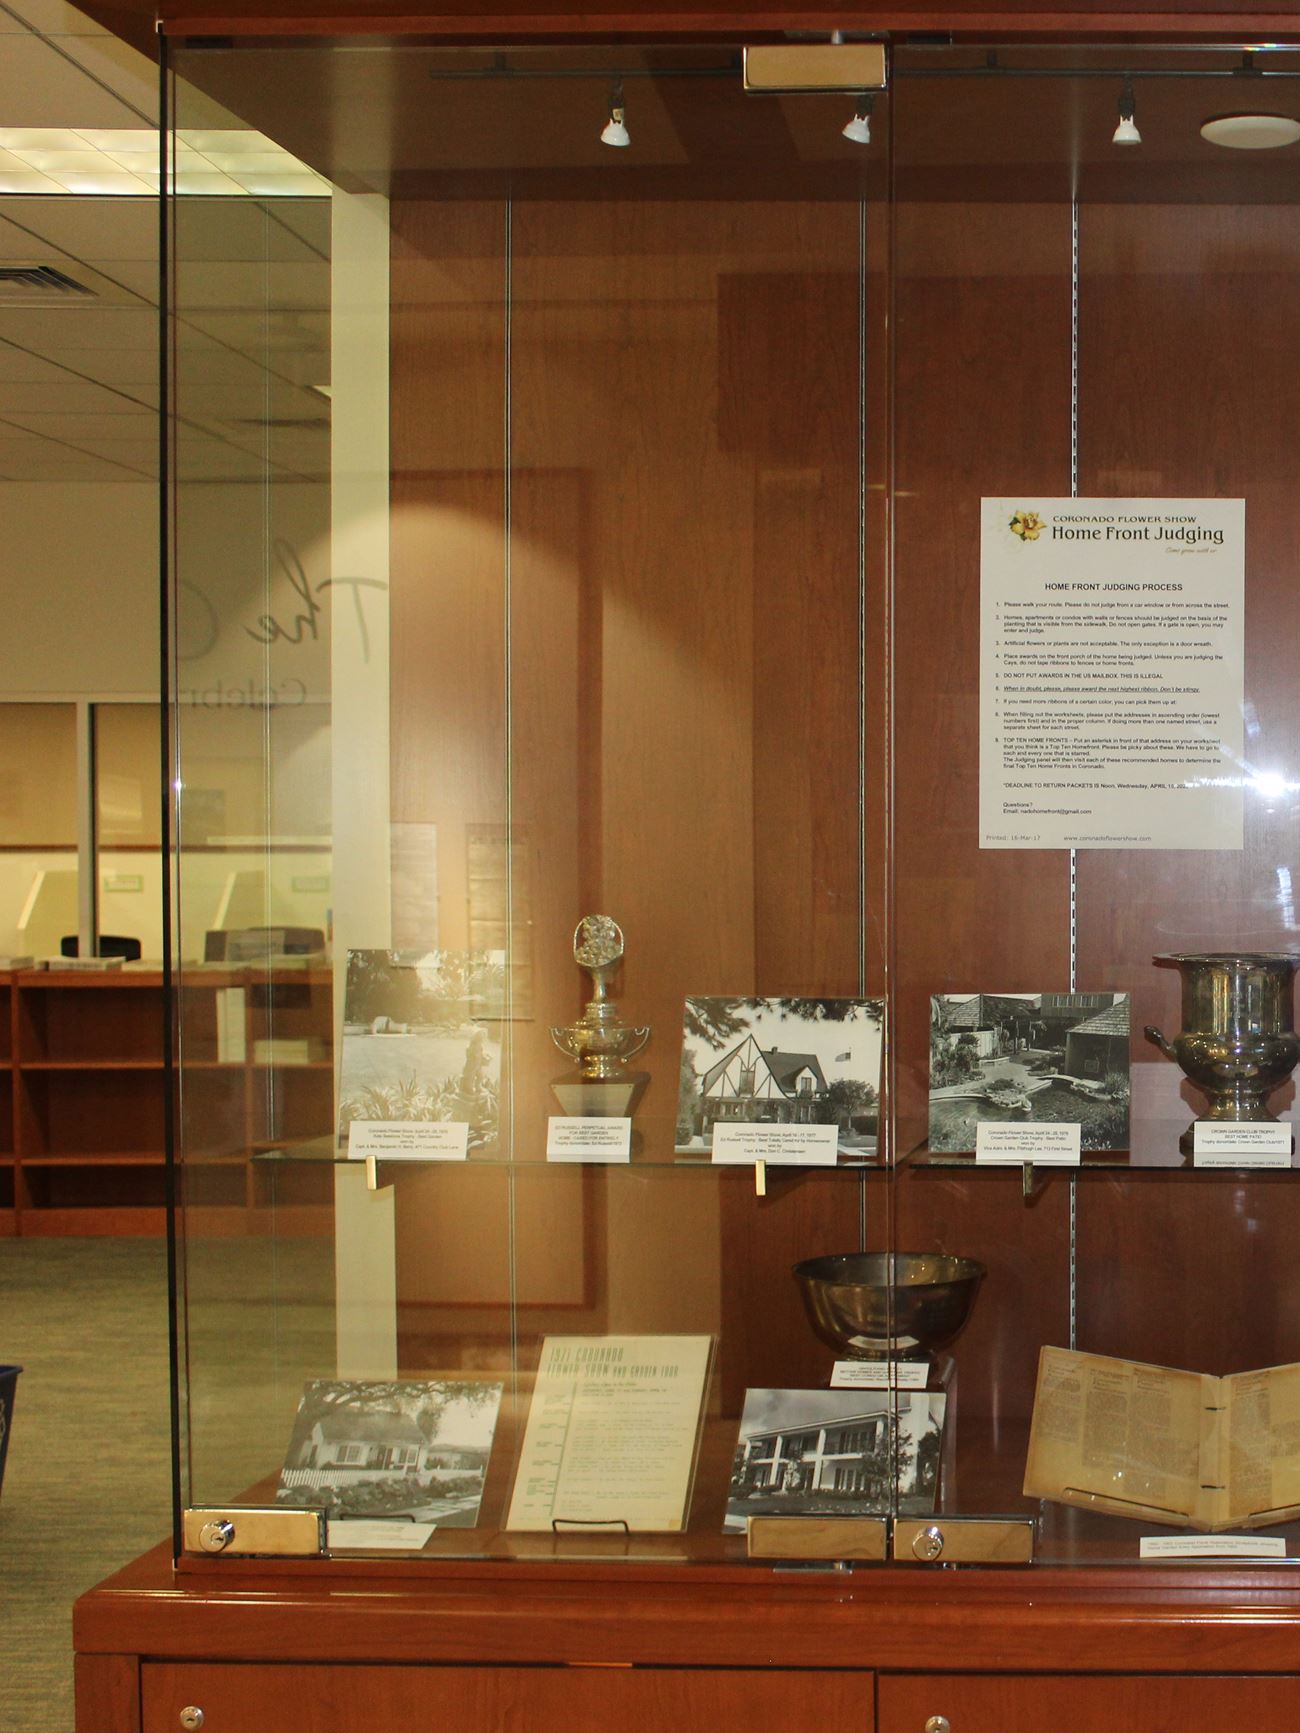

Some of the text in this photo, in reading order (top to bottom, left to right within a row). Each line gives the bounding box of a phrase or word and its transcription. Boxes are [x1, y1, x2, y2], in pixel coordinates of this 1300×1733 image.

[1052, 526, 1224, 544] Home Front Judging
